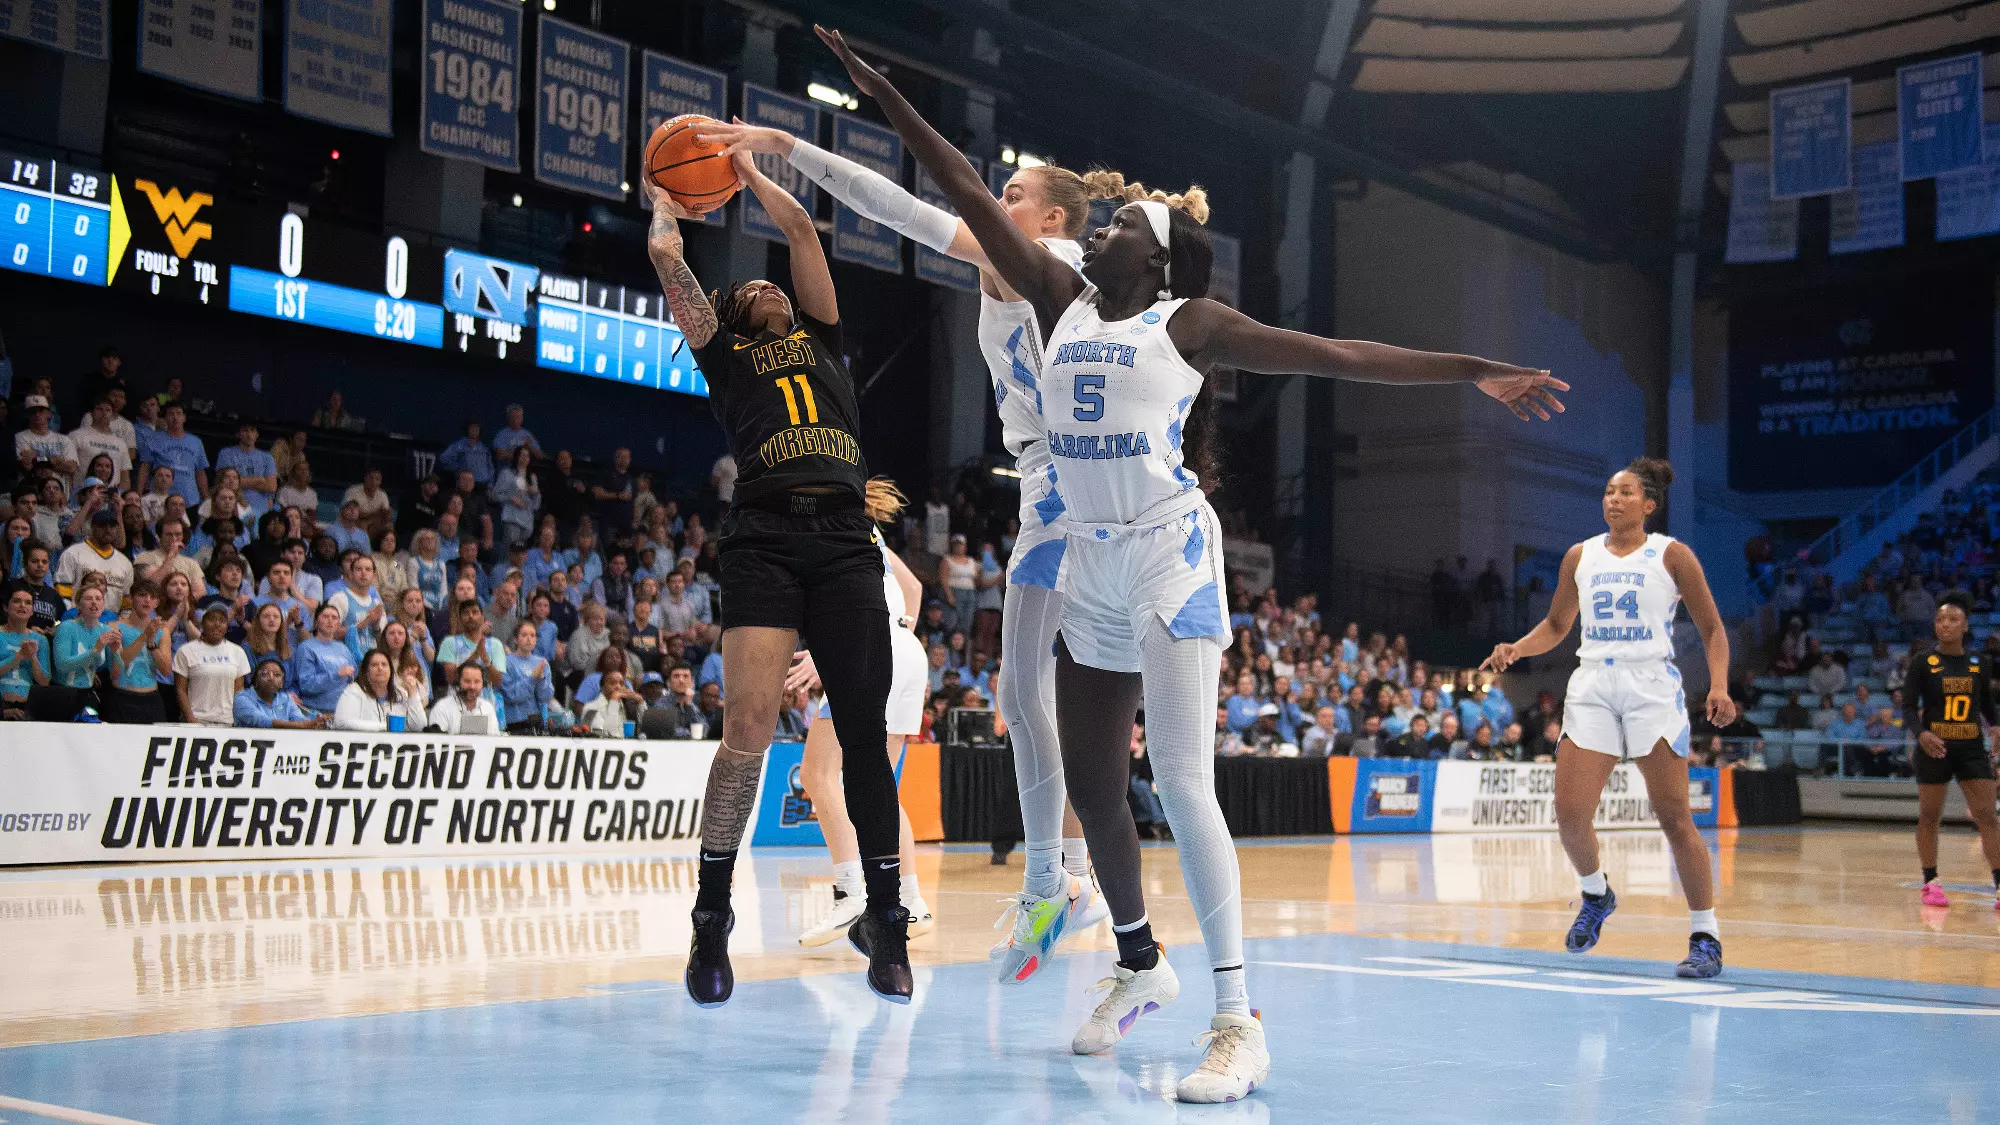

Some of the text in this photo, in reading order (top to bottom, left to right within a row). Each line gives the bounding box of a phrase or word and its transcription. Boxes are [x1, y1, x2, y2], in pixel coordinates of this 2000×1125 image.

[443, 2, 505, 36] WOMEN'S
[431, 22, 512, 65] BASKETBALL
[555, 35, 613, 70] WOMEN'S
[430, 48, 512, 113] 1984
[545, 56, 620, 98] BASKETBALL
[457, 104, 486, 128] ACC
[543, 82, 621, 144] 1994
[430, 121, 511, 158] CHAMPIONS
[568, 135, 596, 157] ACC
[12, 160, 98, 198] 14 32
[543, 152, 618, 186] CHAMPIONS
[15, 202, 90, 236] 0 0
[13, 243, 88, 277] 0 0
[280, 213, 303, 278] 0
[136, 248, 218, 285] FOULS TOL
[386, 236, 408, 299] 0
[151, 274, 208, 304] 0 4
[540, 275, 580, 302] PLAYER
[274, 279, 415, 340] 1ST 9:20
[455, 313, 521, 344] TOL FOULS
[540, 309, 577, 332] POINTS
[597, 322, 608, 341] 0
[635, 330, 645, 348] 0
[460, 337, 507, 360] 4 0
[541, 342, 681, 388] FOULS 0 0 0
[751, 338, 816, 376] WEST
[1053, 341, 1137, 368] NORTH
[1761, 348, 1956, 378] PLAYING AT CAROLINA
[775, 373, 819, 426] 11
[1074, 375, 1105, 422] 5
[1781, 378, 1796, 391] IS
[1800, 376, 1825, 390] AN
[1759, 390, 1958, 417] WINNING AT CAROLINA
[1758, 420, 1773, 433] IS
[1778, 419, 1790, 432] A
[760, 427, 860, 467] VIRGINIA
[1048, 430, 1151, 460] CAROLINA
[413, 449, 437, 480] 117
[1590, 571, 1645, 588] NORTH
[1592, 589, 1638, 619] 24
[1585, 625, 1653, 641] CAROLINA
[1943, 694, 1972, 721] 10
[141, 737, 648, 790] FIRST AND SECOND ROUNDS
[1479, 768, 1515, 794] FIRST
[67, 813, 91, 832] BY
[101, 797, 376, 849] UNIVERSITY
[384, 798, 438, 844] OF
[447, 798, 574, 844] NORTH
[583, 798, 703, 842] CAROLI
[1472, 799, 1547, 826] UNIVERSITY
